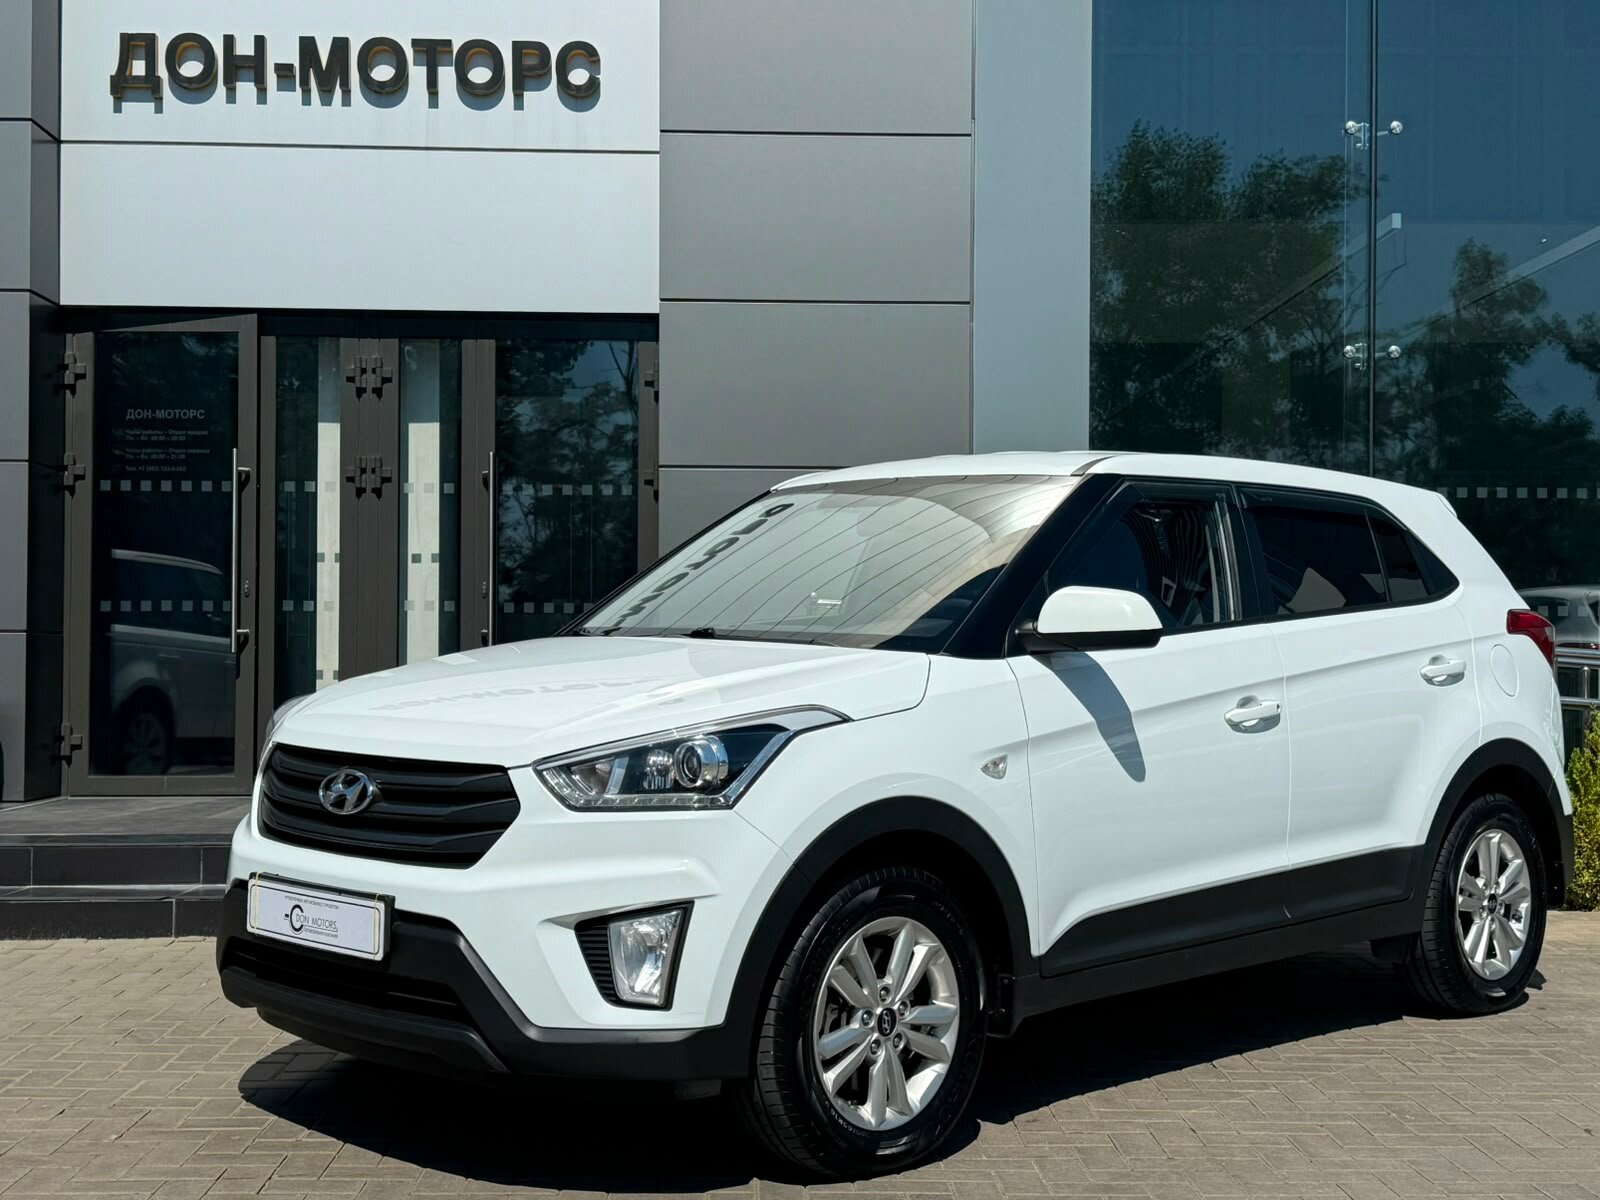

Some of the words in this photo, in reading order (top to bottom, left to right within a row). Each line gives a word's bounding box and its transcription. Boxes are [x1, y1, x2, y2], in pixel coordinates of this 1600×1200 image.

[110, 32, 600, 99] ДОН-МОТОРС
[125, 409, 205, 420] ДОН-МОТОРС
[296, 913, 310, 924] DON
[311, 917, 337, 929] MOTORS
